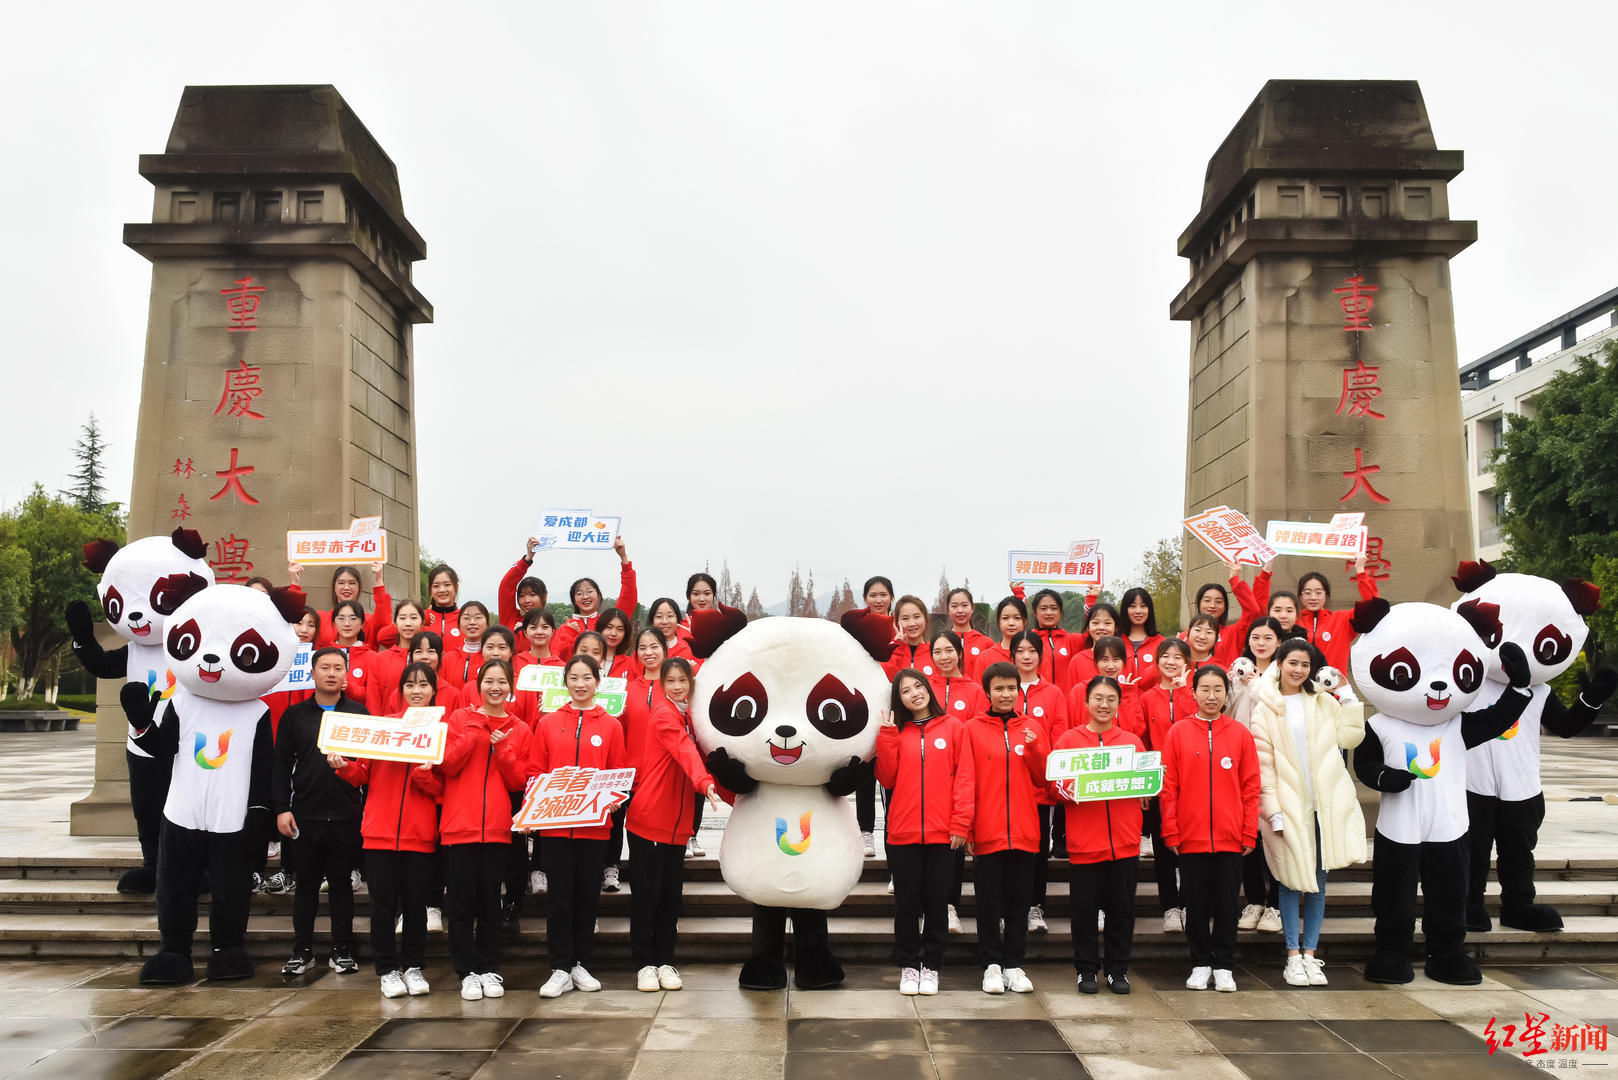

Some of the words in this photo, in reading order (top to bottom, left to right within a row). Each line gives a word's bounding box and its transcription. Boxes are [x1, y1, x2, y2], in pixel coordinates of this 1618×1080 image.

[209, 275, 267, 584] 重慶大學
[544, 515, 588, 527] 爱成都
[567, 530, 611, 543] 迎大运
[1275, 529, 1358, 547] 领跑青春路
[296, 539, 376, 554] 追梦赤子心
[1016, 560, 1095, 576] 领跑青春路
[329, 725, 432, 749] 追梦赤子心
[544, 768, 597, 793] 青春
[531, 791, 601, 820] 领跑人
